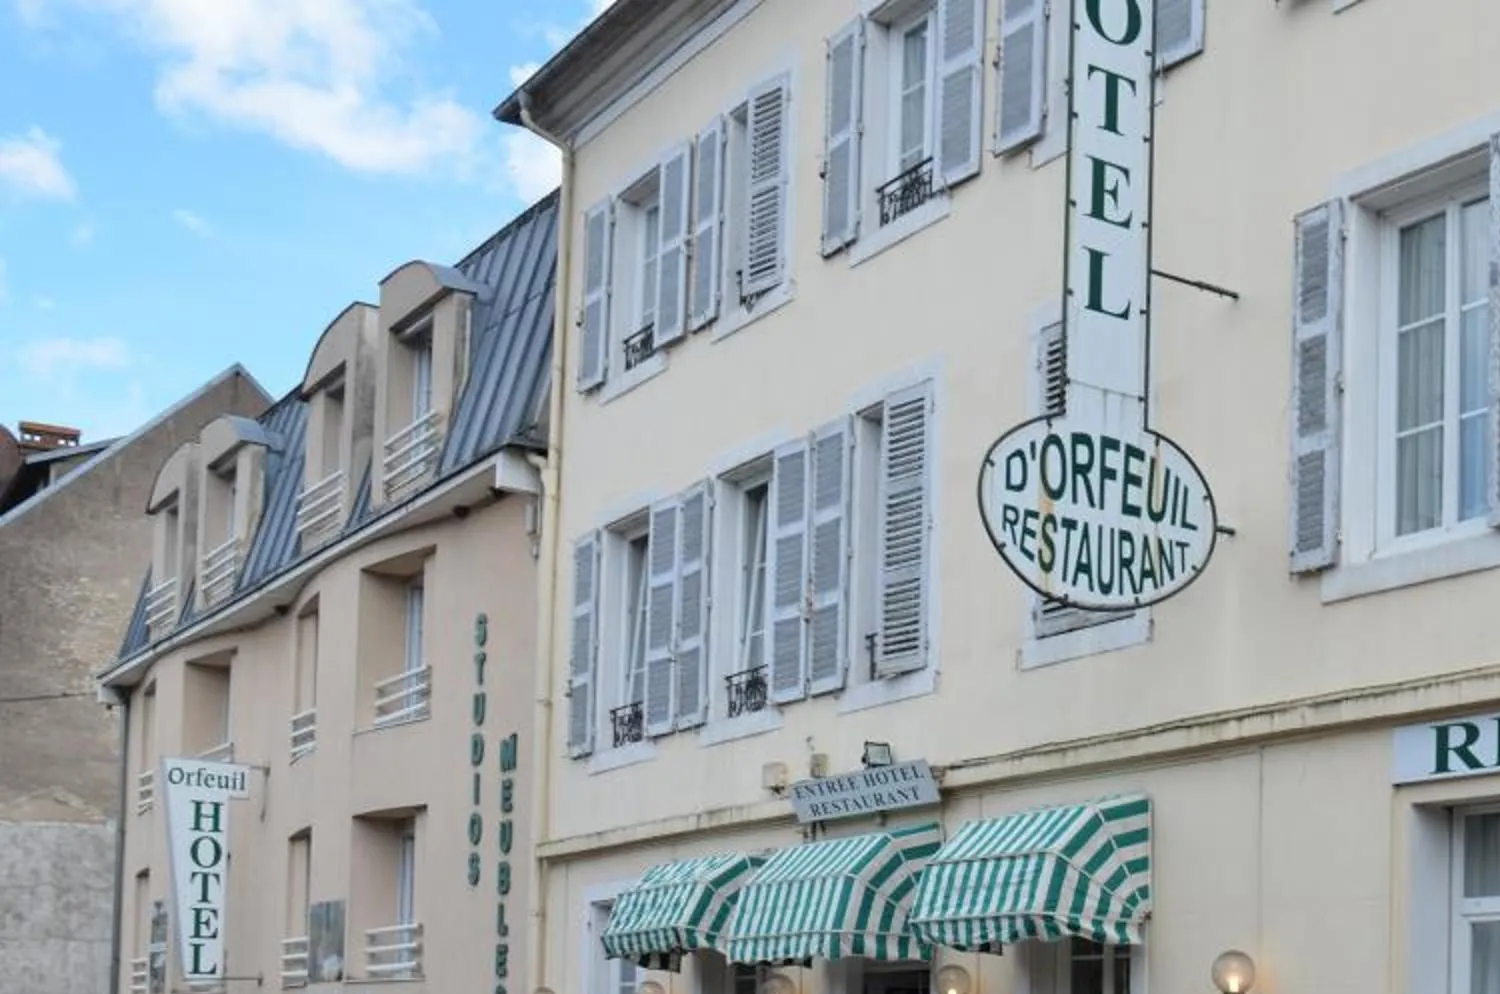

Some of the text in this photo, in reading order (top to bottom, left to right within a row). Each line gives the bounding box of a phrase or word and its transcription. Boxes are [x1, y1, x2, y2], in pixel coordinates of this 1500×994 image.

[1005, 432, 1198, 531] D'ORFEUIL
[1002, 504, 1190, 595] RESTAURANT
[168, 767, 246, 791] Orfeuil
[468, 613, 488, 887] STUDIOS
[809, 786, 920, 816] RESTAURANT
[189, 800, 224, 975] HOTEL
